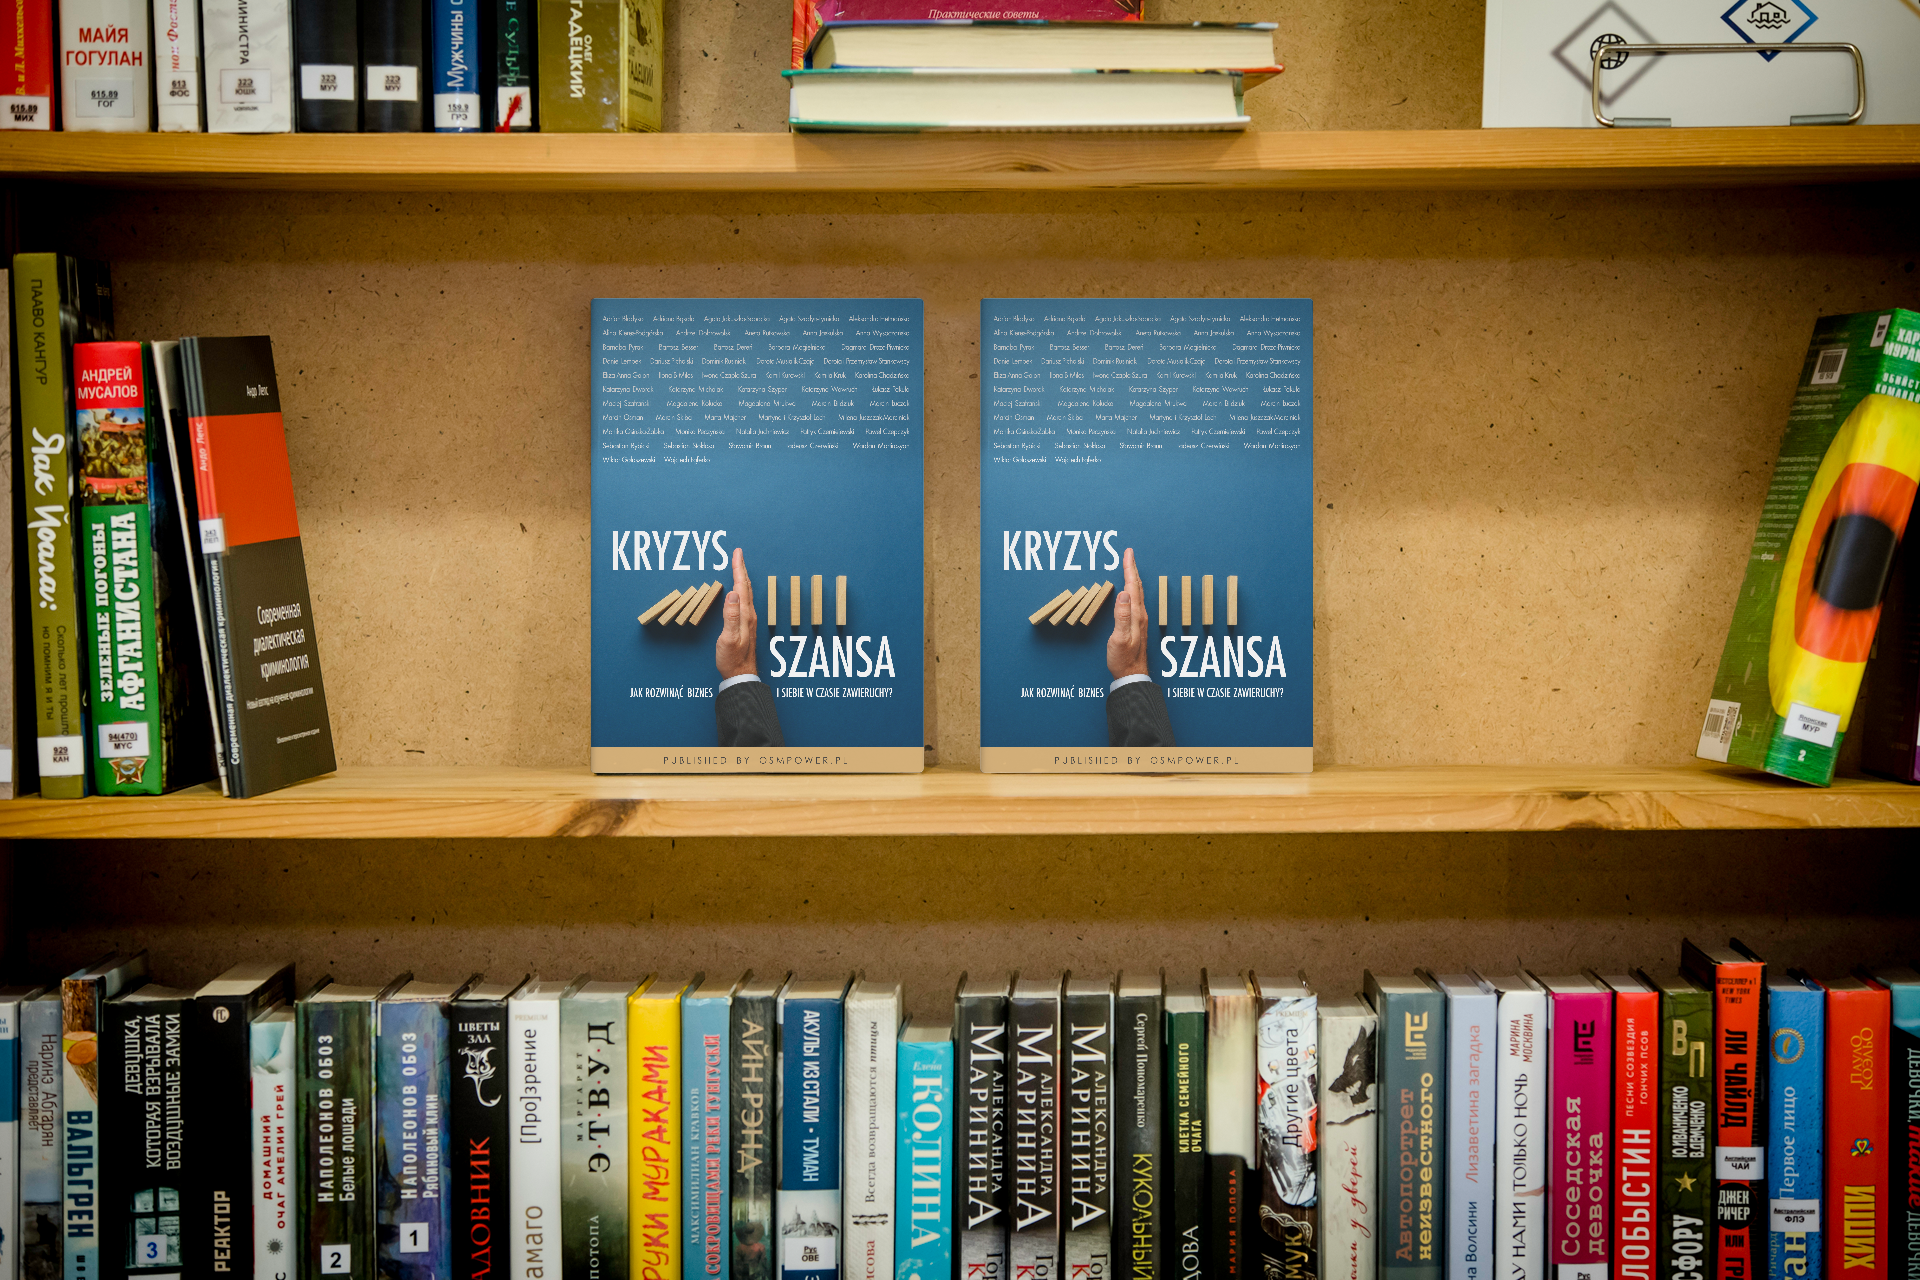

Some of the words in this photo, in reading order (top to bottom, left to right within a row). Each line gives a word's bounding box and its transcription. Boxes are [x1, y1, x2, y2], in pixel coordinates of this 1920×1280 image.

[79, 24, 128, 43] МАЙЯ
[928, 8, 1000, 21] Практические
[1002, 9, 1040, 20] советы
[66, 50, 142, 66] ГОГУЛАН
[447, 11, 469, 87] Мужчины
[584, 34, 593, 63] ОЛЕГ
[91, 90, 118, 98] 615.89
[98, 100, 115, 108] ГОГ
[169, 89, 190, 97] ФОС
[171, 80, 186, 88] 613
[14, 114, 34, 122] МИХ
[31, 279, 44, 328] ПААВО
[33, 332, 48, 385] КАНГУР
[1896, 328, 1920, 345] ХАР
[77, 384, 138, 400] МУСАЛОВ
[81, 366, 132, 383] АНДРЕЙ
[92, 523, 108, 607] ПОГОНЫ
[612, 529, 729, 571] KRYZYS
[1003, 529, 1120, 571] KRYZYS
[110, 511, 146, 711] АФГАНИСТАНА
[211, 559, 227, 628] криминология
[257, 602, 301, 627] Современная
[96, 612, 114, 703] ЗЕЛЕНЫЕ
[253, 628, 305, 656] диалектическая
[769, 635, 896, 678] SZANSA
[1160, 635, 1287, 678] SZANSA
[217, 628, 234, 710] диалектическая
[260, 654, 310, 682] криминология
[629, 687, 643, 698] JAK
[645, 685, 684, 700] ROZWINĄĆ
[687, 687, 713, 698] BIZNES
[781, 687, 804, 698] SIEBIE
[815, 687, 840, 698] CZASIE
[1020, 687, 1034, 698] JAK
[1036, 685, 1075, 700] ROZWINĄĆ
[1078, 687, 1104, 698] BIZNES
[1172, 687, 1195, 698] SIEBIE
[1206, 687, 1231, 698] CZASIE
[108, 731, 138, 742] 94(470)
[113, 742, 133, 750] МУС
[225, 709, 240, 765] Современная
[1798, 749, 1806, 761] 2
[736, 756, 749, 765] BY
[1127, 756, 1140, 765] BY
[165, 1013, 180, 1068] ЗАМКИ
[458, 1022, 500, 1034] ЦВЕТЫ
[467, 1034, 491, 1044] ЗЛА
[741, 1018, 769, 1083] АЙН
[803, 1009, 820, 1057] АКУЛЫ
[869, 1021, 878, 1063] птицы
[1134, 1013, 1148, 1052] Сергей
[1510, 1019, 1521, 1057] МАРИНА
[1523, 1013, 1533, 1062] МОСКВИНА
[1626, 1018, 1635, 1078] СОЗВЕЗДИЯ
[1641, 1030, 1649, 1059] ПСОВ
[1724, 1028, 1748, 1055] ЛИ
[38, 1034, 57, 1084] Наринэ
[125, 1015, 143, 1095] ДЕВУШКА,
[145, 1013, 161, 1096] ВЗРЫВАЛА
[318, 1034, 334, 1079] ОБОЗ
[402, 1032, 417, 1076] ОБОЗ
[704, 1034, 721, 1112] ТУНГУСКИ
[802, 1060, 820, 1080] ИЗ
[1177, 1043, 1189, 1107] СЕМЕЙНОГО
[1286, 1028, 1302, 1078] цвета
[1469, 1025, 1484, 1086] загадка
[26, 1060, 39, 1131] представляет
[274, 1085, 285, 1119] ГРЕЙ
[520, 1028, 541, 1144] [Про]зрение
[802, 1081, 820, 1124] СТАЛИ
[1134, 1054, 1148, 1128] Пономаренко
[1514, 1073, 1528, 1118] НОЧЬ
[1626, 1081, 1634, 1117] ПЕСНИ
[1640, 1062, 1648, 1104] ГОНЧИХ
[1720, 1063, 1752, 1128] ЧАЙЛД
[38, 1091, 58, 1147] Абгарян
[166, 1073, 183, 1170] ВОЗДУШНЫЕ
[342, 1098, 357, 1152] лошади
[426, 1094, 439, 1126] клин
[642, 1045, 671, 1203] МУРАКАМИ
[690, 1088, 699, 1141] КРАВКОВ
[868, 1066, 879, 1159] возвращаются
[990, 1070, 1004, 1194] АЛЕКСАНДРА
[1283, 1083, 1303, 1148] Другие
[1782, 1086, 1797, 1133] лицо
[146, 1102, 161, 1168] КОТОРАЯ
[277, 1126, 285, 1185] АМЕЛИИ
[318, 1088, 334, 1202] НАПОЛЕОНОВ
[401, 1085, 417, 1199] НАПОЛЕОНОВ
[705, 1115, 721, 1154] РЕКИ
[1040, 1072, 1053, 1196] АЛЕКСАНДРА
[1094, 1071, 1107, 1195] АЛЕКСАНДРА
[1179, 1113, 1189, 1153] КЛЕТКА
[1191, 1119, 1202, 1153] ОЧАГА
[1465, 1091, 1479, 1183] Лизаветина
[66, 1110, 94, 1238] ВАЛЬГРЕН
[262, 1115, 273, 1200] ДОМАШНИЙ
[339, 1155, 355, 1201] Белые
[422, 1128, 439, 1198] Рябиновый
[802, 1136, 820, 1182] ТУМАН
[911, 1075, 943, 1249] КОЛИНА
[1396, 1088, 1418, 1261] Автопортрет
[1419, 1072, 1433, 1260] неизвестного
[1513, 1123, 1528, 1191] ТОЛЬКО
[1561, 1096, 1583, 1256] Соседская
[1731, 1161, 1750, 1170] ЧАЙ
[1779, 1136, 1796, 1199] Первое
[690, 1144, 700, 1245] МАКСИМИЛИАН
[865, 1160, 879, 1203] Всегда
[1229, 1170, 1237, 1223] ПОПОВА
[1589, 1132, 1605, 1256] девочка
[1718, 1189, 1749, 1206] ДЖЕК
[214, 1190, 231, 1272] РЕАКТОР
[277, 1191, 286, 1229] ОЧАГ
[704, 1158, 723, 1275] СОКРОВИЩАМИ
[1465, 1201, 1478, 1262] Волсини
[1512, 1202, 1526, 1258] НАМИ
[1717, 1206, 1750, 1221] РИЧЕР
[1784, 1215, 1805, 1223] ФЛЭ
[1844, 1185, 1876, 1270] ХИППИ
[146, 1241, 158, 1258] 3
[330, 1252, 341, 1268] 2
[409, 1230, 418, 1246] 1
[801, 1254, 820, 1262] ОВЕ
[1229, 1230, 1237, 1274] МАРИЯ
[1725, 1235, 1744, 1248] ИЛИ
